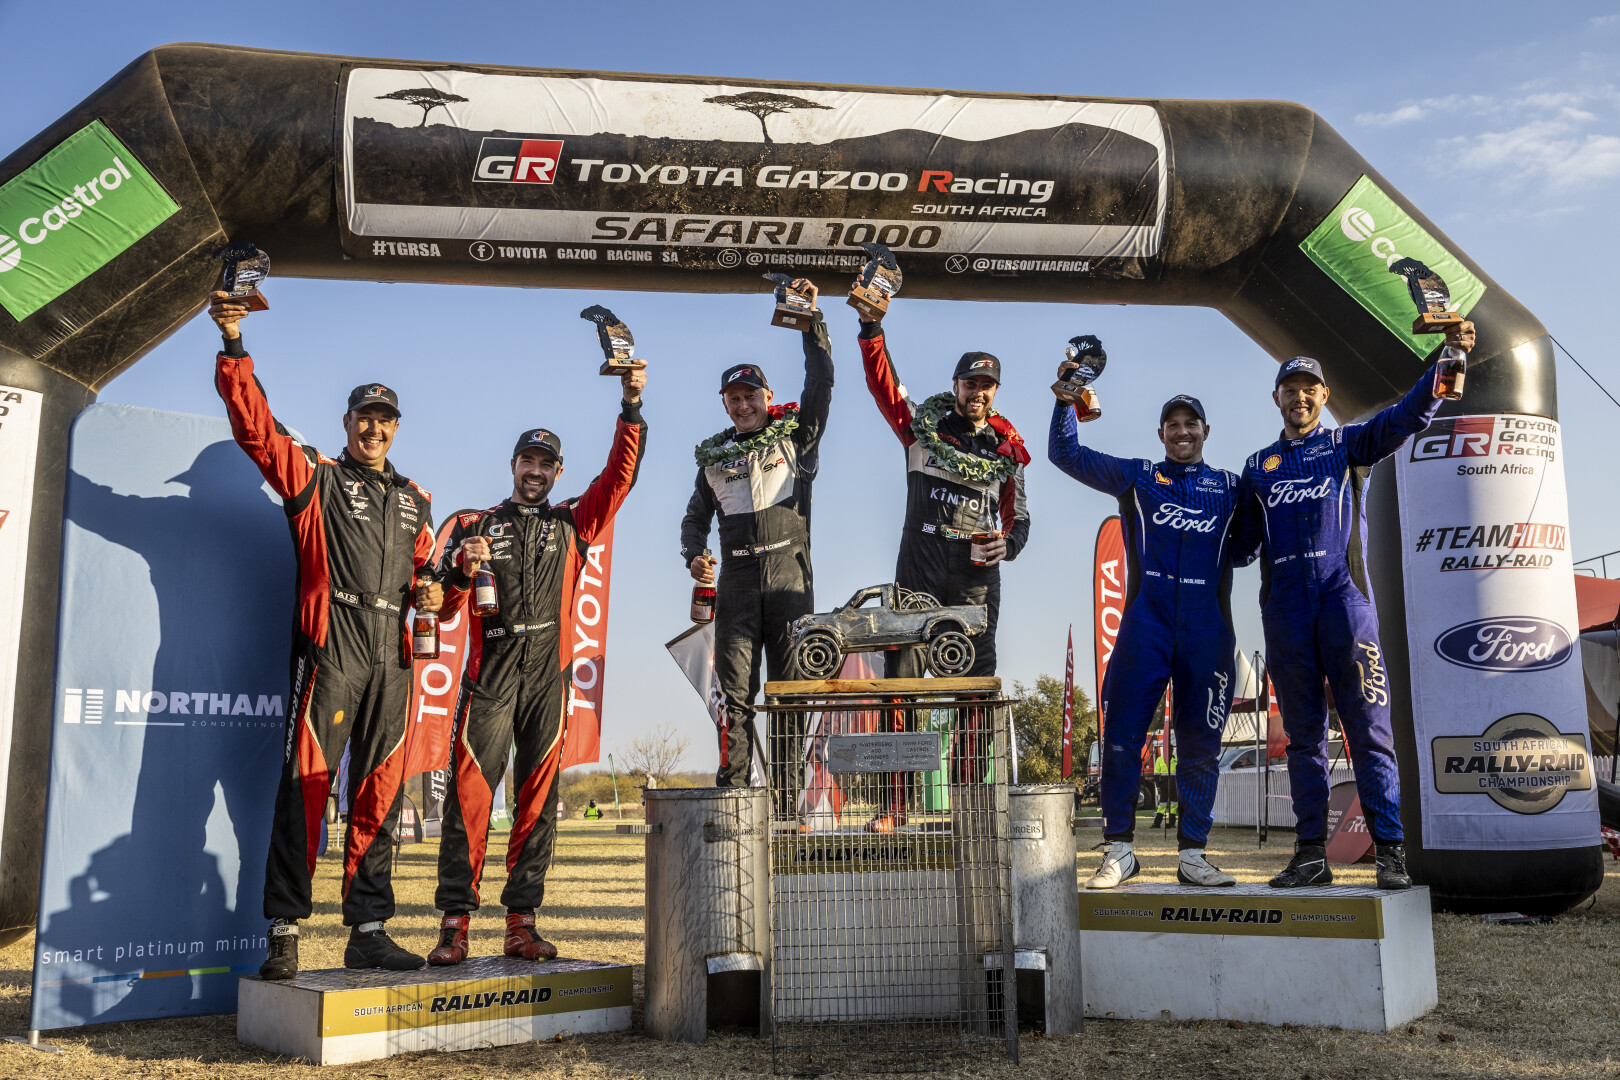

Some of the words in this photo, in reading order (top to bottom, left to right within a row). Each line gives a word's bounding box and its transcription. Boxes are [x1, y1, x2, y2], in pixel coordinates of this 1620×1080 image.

[478, 155, 555, 182] GR
[571, 158, 742, 187] TOYOTA
[755, 165, 908, 192] GAZOO
[918, 170, 1055, 204] Racing
[19, 156, 132, 245] Castrol
[911, 204, 974, 215] SOUTH
[978, 205, 1046, 217] AFRICA
[591, 216, 804, 246] SAFARI
[826, 221, 942, 249] 1000
[373, 240, 441, 257] #TGRSA
[498, 246, 548, 260] TOYOTA
[557, 248, 597, 261] GAZOO
[607, 249, 652, 262] RACING
[662, 250, 679, 263] SA
[746, 252, 867, 267] @TGRSOUTHAFRICA
[973, 258, 1090, 273] @TGRSOUTHAFRICA
[1286, 359, 1314, 370] Ford
[1501, 417, 1557, 435] TOYOTA
[1414, 433, 1490, 459] GR
[1498, 431, 1556, 447] GAZOO
[1496, 444, 1555, 462] Racing
[1457, 464, 1497, 476] South
[1500, 464, 1534, 475] Africa
[1267, 476, 1331, 508] Ford
[1152, 502, 1218, 533] Ford
[1416, 522, 1566, 552] #TEAMHILUX
[1441, 554, 1553, 570] RALLY-RAID
[1101, 559, 1122, 672] YOTA
[569, 544, 605, 716] TOYOTA
[1468, 624, 1556, 662] Ford
[1356, 641, 1388, 707] Ford
[114, 689, 284, 717] NORTHAM
[1206, 671, 1229, 733] Ford
[192, 720, 284, 728] ZONDEREINDE
[1473, 741, 1518, 752] SOUTH
[1522, 739, 1569, 751] AFRICAN
[1444, 753, 1585, 774] RALLY-RAID
[1478, 775, 1571, 788] CHAMPIONSHIP
[1094, 908, 1119, 917] SOUTH
[1120, 908, 1154, 917] AFRICAN
[1160, 906, 1283, 924] RALLY-RAID
[1290, 913, 1357, 923] CHAMPIONSHIP
[42, 946, 103, 965] smart
[114, 939, 205, 962] platinum
[216, 934, 267, 952] minin
[354, 1005, 384, 1017] SOUTH
[385, 1002, 423, 1015] AFRICAN
[430, 987, 552, 1013] RALLY-RAID
[558, 984, 615, 998] CHAMPIONSHIP
